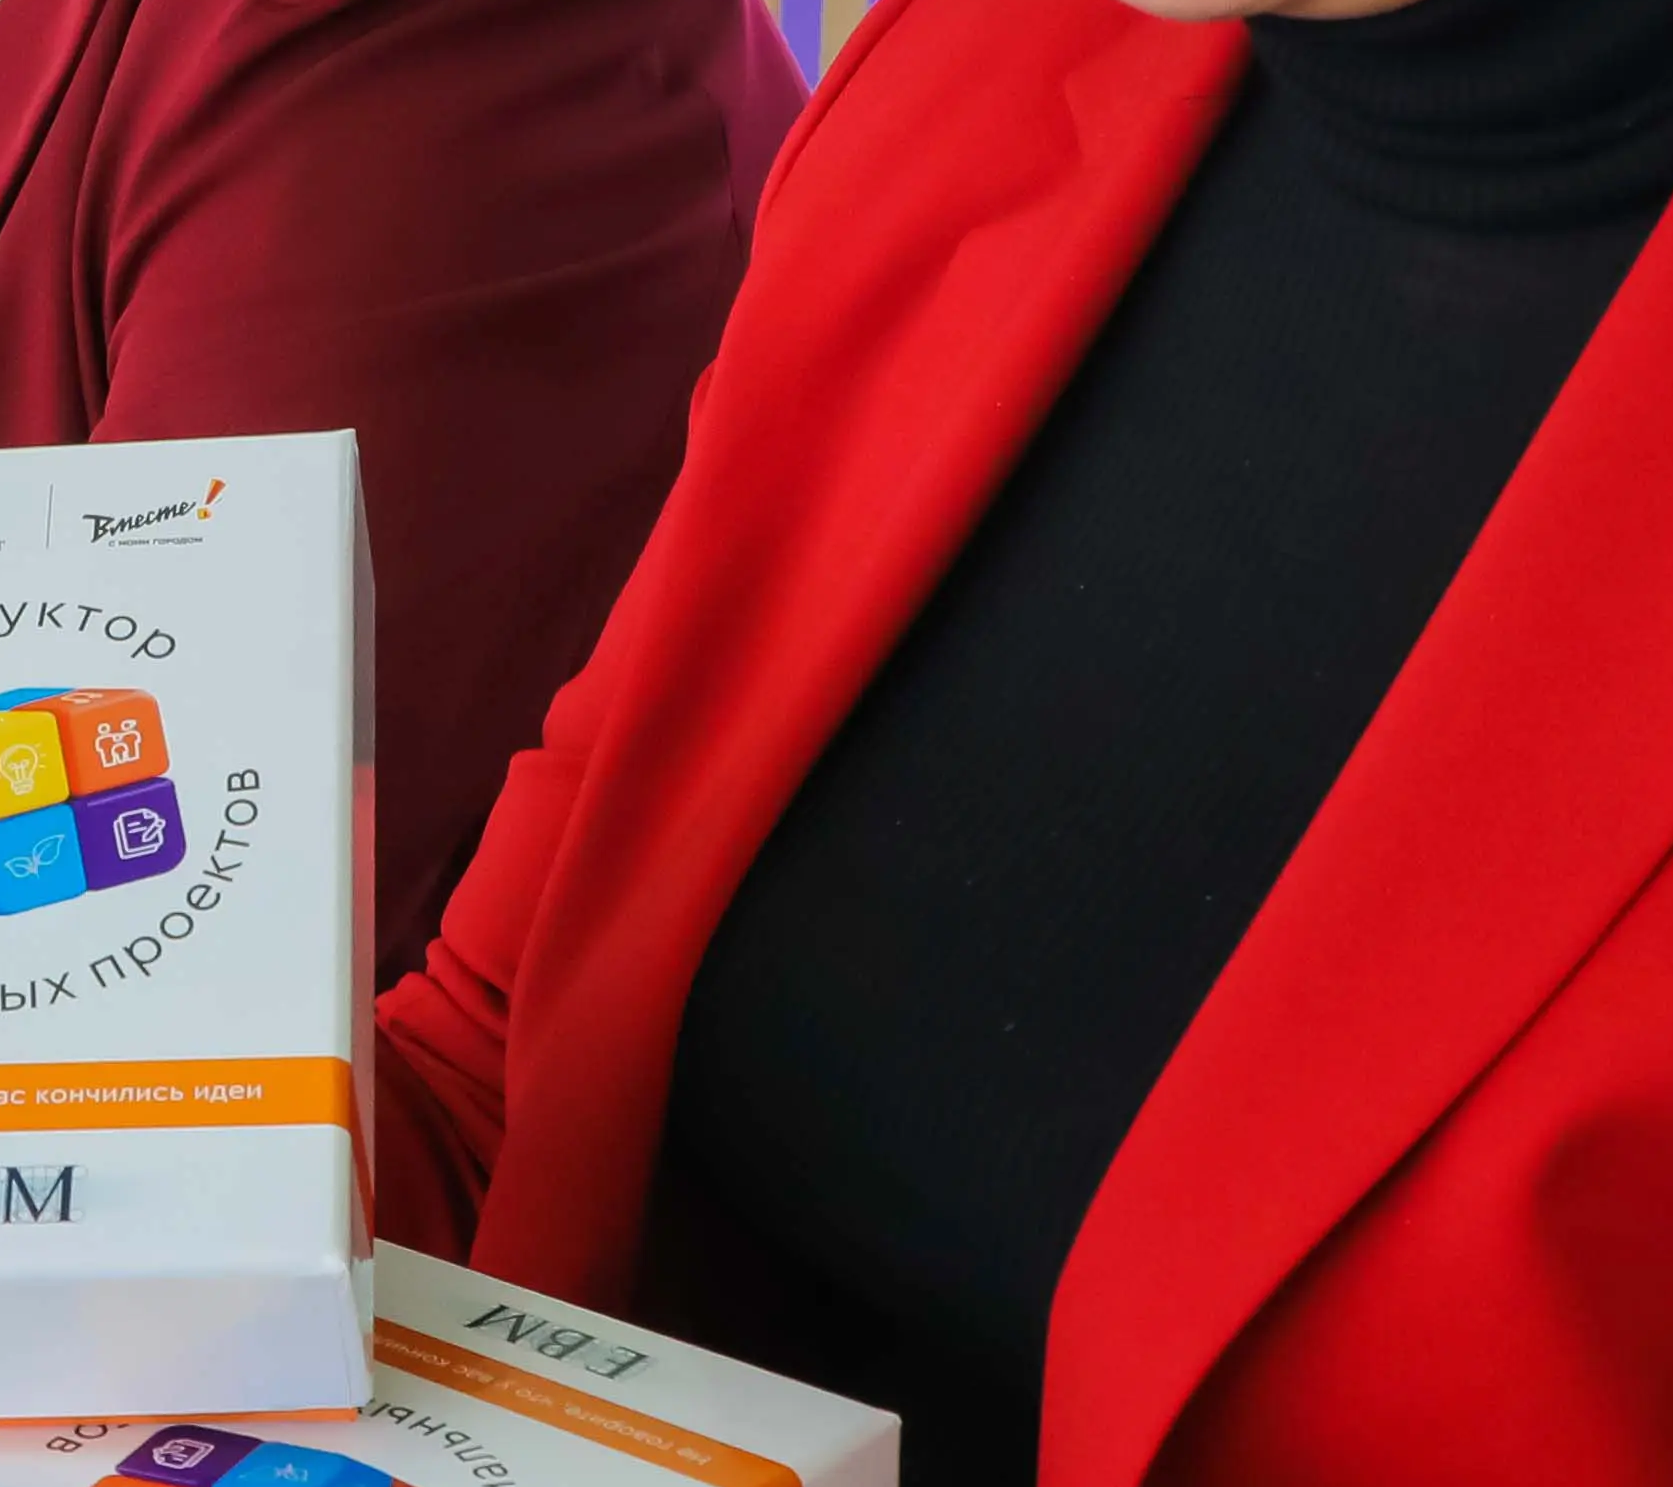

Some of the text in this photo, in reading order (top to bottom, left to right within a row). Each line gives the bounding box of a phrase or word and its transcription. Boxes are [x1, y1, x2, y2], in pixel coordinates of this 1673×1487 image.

[82, 477, 227, 544] Вместе!
[88, 766, 263, 990] проектов
[35, 1085, 184, 1104] кончились
[193, 1083, 262, 1103] идеи
